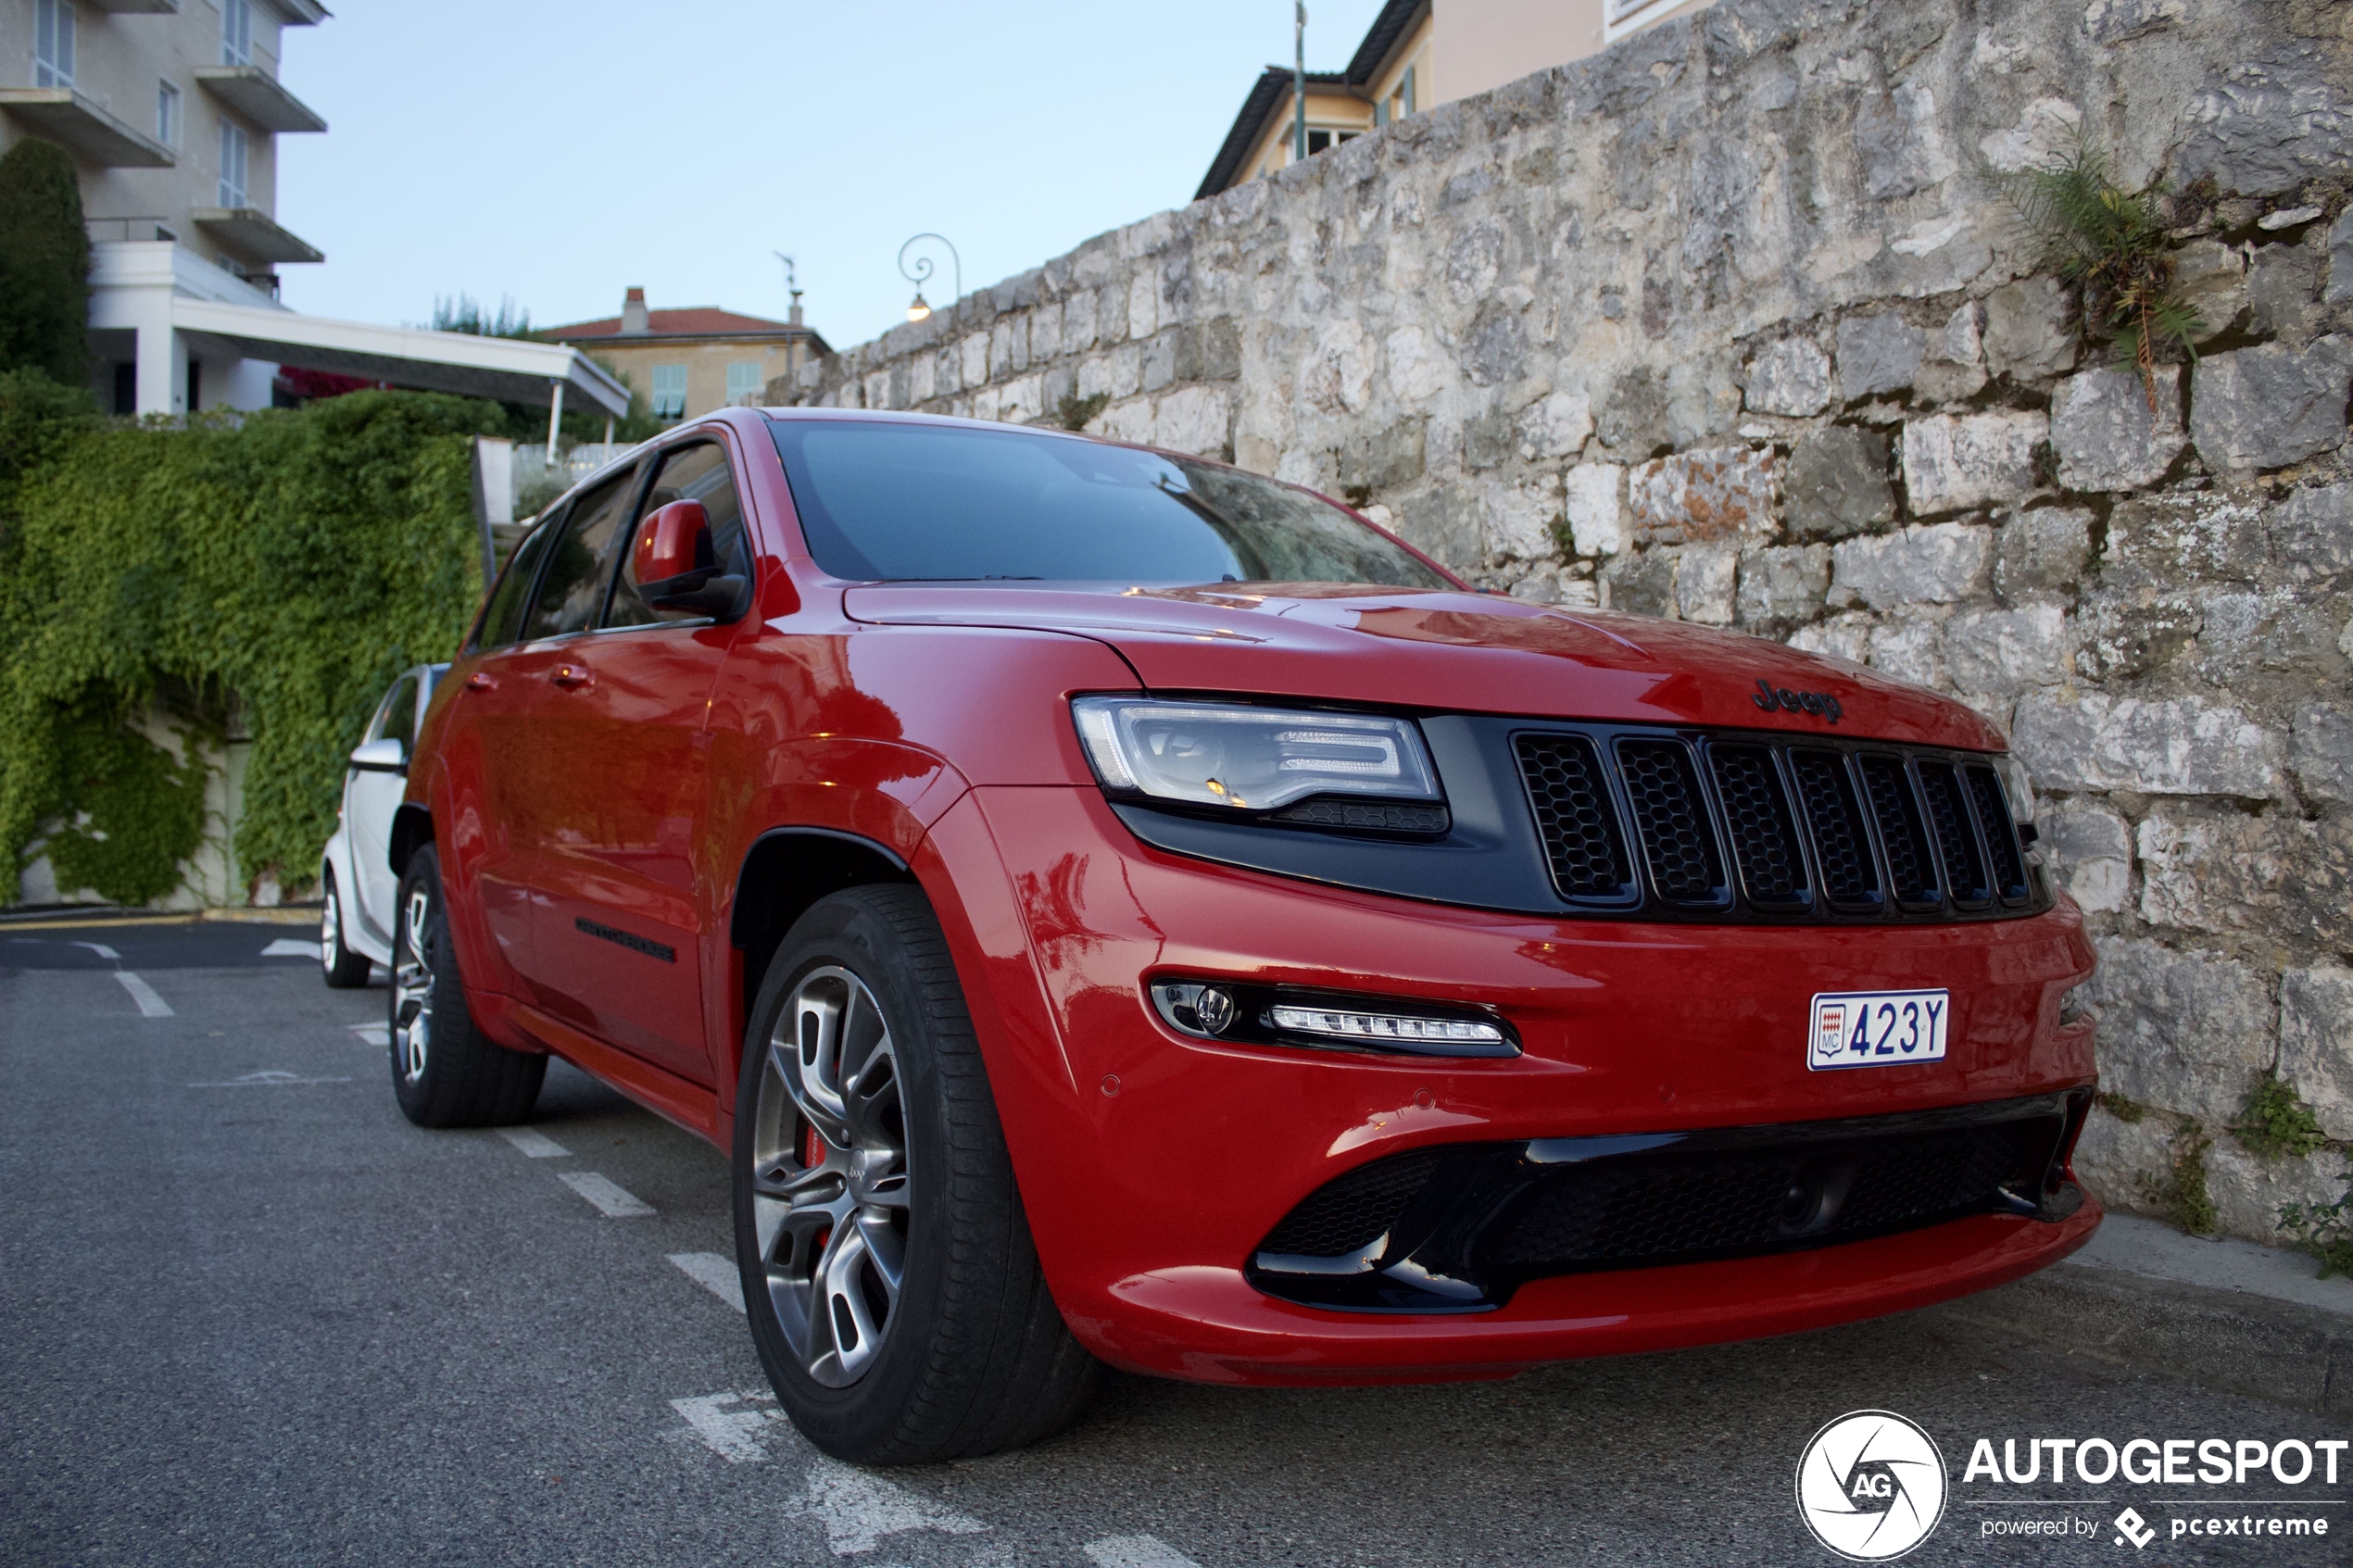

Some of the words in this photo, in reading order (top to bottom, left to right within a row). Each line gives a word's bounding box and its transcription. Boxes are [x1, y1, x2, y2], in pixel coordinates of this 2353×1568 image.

[1752, 678, 1843, 724] Jeep
[1821, 1033, 1839, 1048] MC
[1849, 999, 1943, 1057] 423Y
